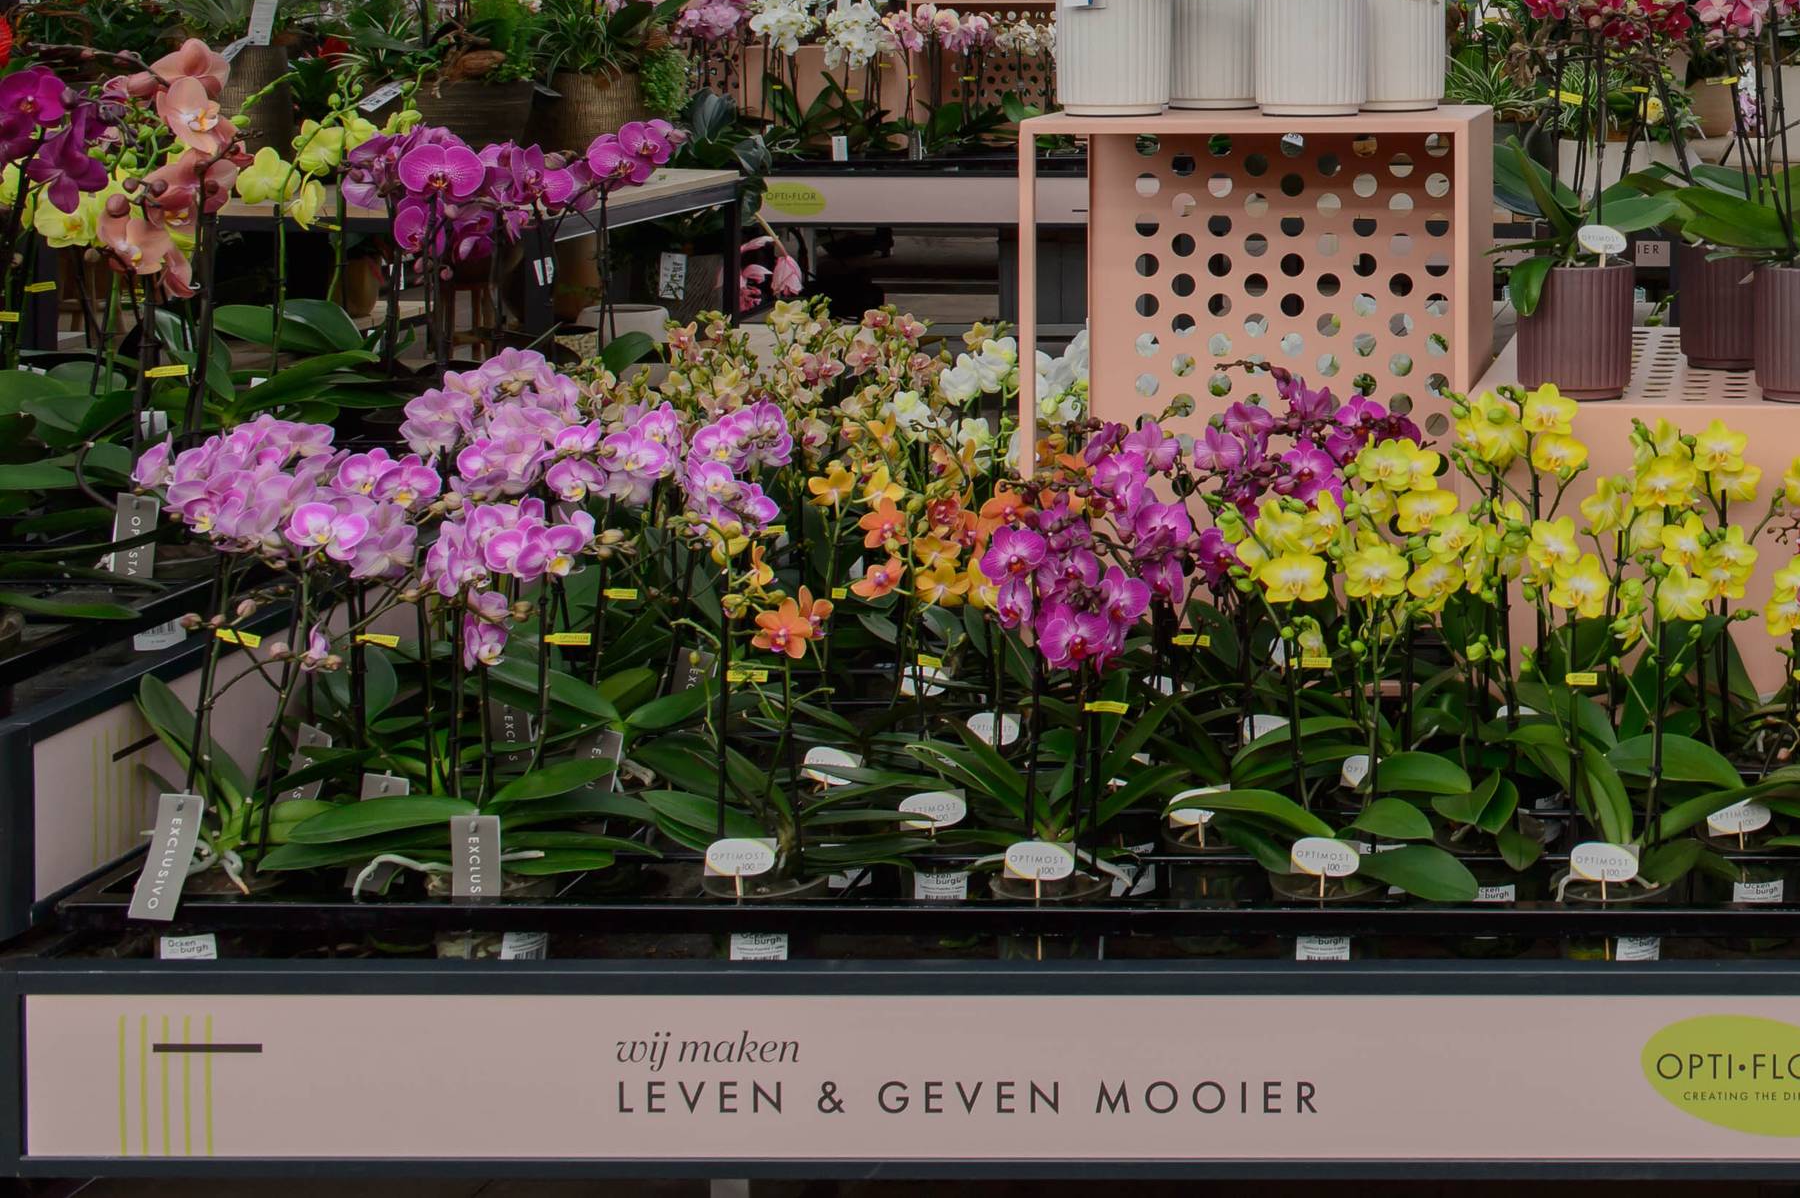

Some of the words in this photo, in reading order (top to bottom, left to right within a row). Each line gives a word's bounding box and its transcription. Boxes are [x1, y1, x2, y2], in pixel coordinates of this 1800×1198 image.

[127, 515, 141, 576] OPSTA
[710, 851, 766, 862] OPTIMOST
[1009, 853, 1065, 865] OPTIMOST
[1296, 850, 1350, 862] OPTIMOST
[1575, 856, 1630, 867] OPTIMOST
[147, 817, 182, 909] EXCLUSIVO
[468, 836, 482, 894] EXCLUS
[1479, 886, 1501, 894] cken
[1485, 890, 1511, 900] burgh
[1755, 886, 1779, 896] burgh
[168, 938, 197, 949] Ocken
[754, 935, 782, 946] burgh
[1318, 936, 1344, 946] burgh
[179, 942, 209, 953] burgh
[616, 1033, 669, 1071] wij
[679, 1031, 800, 1063] maken
[618, 1081, 784, 1114] LEVEN
[817, 1080, 845, 1115] &
[878, 1080, 1062, 1115] GEVEN
[1096, 1080, 1318, 1115] MOOIER
[1683, 1091, 1749, 1101] CREATING
[1755, 1091, 1777, 1101] THE
